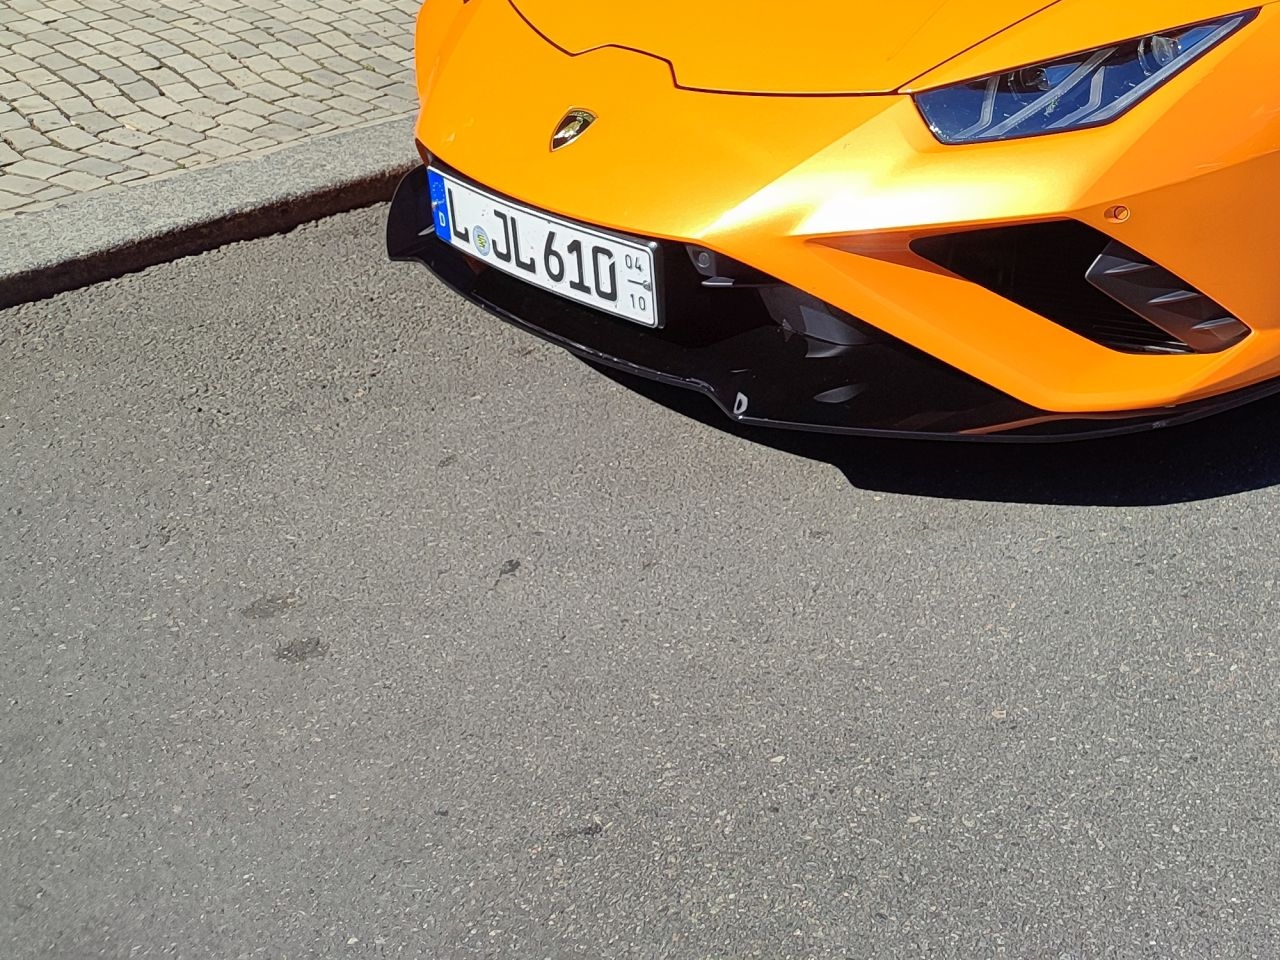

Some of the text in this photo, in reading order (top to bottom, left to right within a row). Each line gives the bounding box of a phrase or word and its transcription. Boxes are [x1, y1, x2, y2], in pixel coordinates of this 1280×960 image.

[438, 211, 445, 228] D
[447, 187, 470, 243] L
[624, 253, 643, 272] 04
[629, 292, 647, 311] 10
